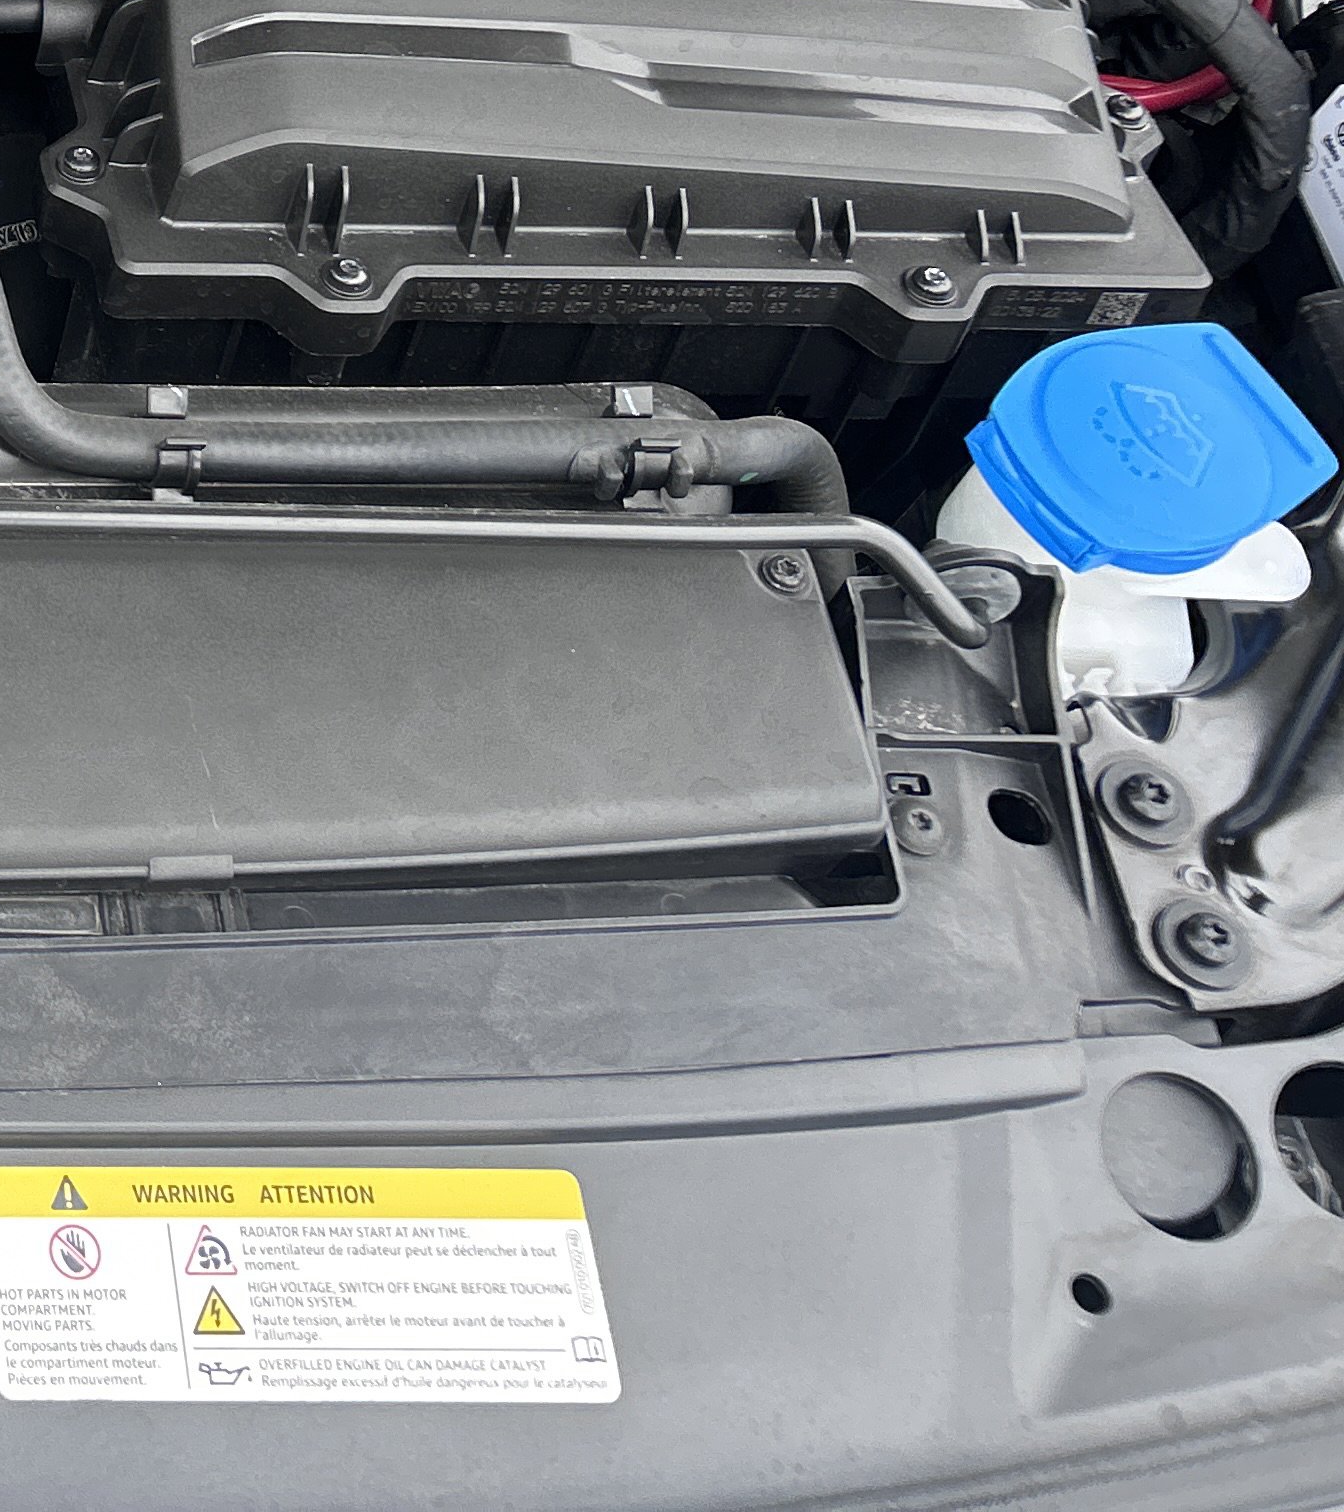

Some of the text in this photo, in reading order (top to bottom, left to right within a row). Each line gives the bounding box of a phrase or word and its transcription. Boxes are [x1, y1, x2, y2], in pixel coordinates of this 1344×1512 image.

[132, 1184, 375, 1205] WARNING ATTENTION
[240, 1226, 470, 1238] RADIATOR FAN MAY START AT ANY TIME.
[243, 1244, 557, 1258] Le ventilateur de radiateur peut se déclencher à tout
[247, 1282, 572, 1294] HIGH VOLTAGE, SWITCH OFF ENGINE BEFORE TOUCHING
[0, 1289, 127, 1300] HOT PARTS IN MOTOR
[250, 1296, 303, 1307] IGNITION
[2, 1320, 95, 1331] MOVING PARTS.
[253, 1314, 290, 1326] Haute
[345, 1314, 386, 1326] arrêter
[390, 1316, 400, 1326] le
[405, 1317, 448, 1327] moteur
[453, 1317, 487, 1327] avant
[491, 1316, 504, 1327] de
[508, 1316, 553, 1327] toucher
[5, 1340, 178, 1354] Composants très chauds dans
[6, 1357, 17, 1368] le
[21, 1358, 109, 1370] compartiment
[259, 1358, 332, 1370] OVERFILLED
[336, 1359, 381, 1371] ENGINE
[384, 1359, 403, 1370] OIL
[408, 1360, 432, 1370] CAN
[436, 1360, 485, 1371] DAMAGE
[8, 1373, 47, 1385] Pièces
[50, 1376, 65, 1385] en
